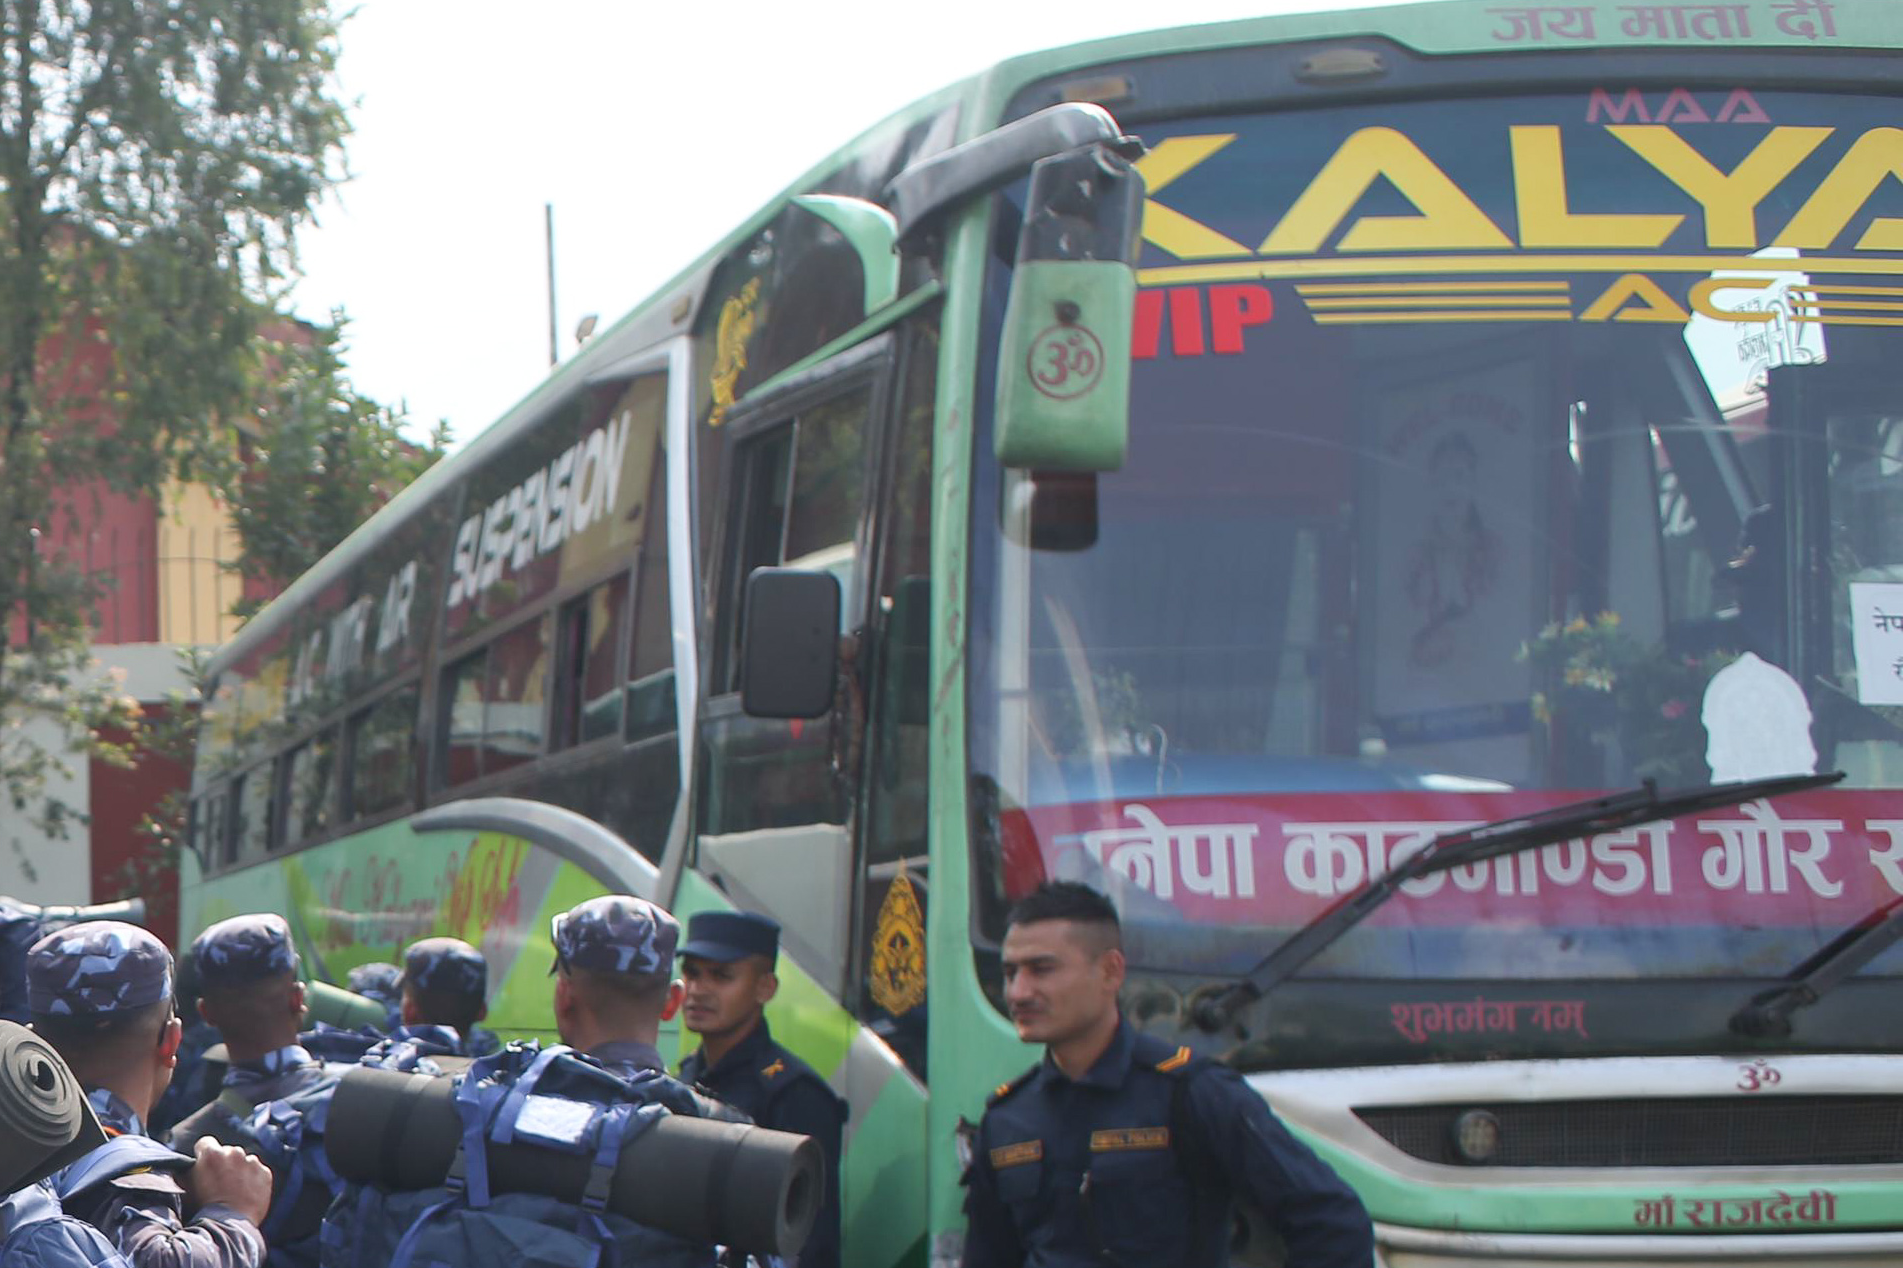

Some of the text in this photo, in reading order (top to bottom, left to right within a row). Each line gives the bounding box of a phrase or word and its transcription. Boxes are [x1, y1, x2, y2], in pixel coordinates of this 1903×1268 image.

[1485, 0, 1838, 42] जय माता दी
[1586, 87, 1772, 124] MAA
[1578, 273, 1779, 323] AC
[446, 409, 633, 608] SUSPENSION
[1697, 796, 1844, 899] गौर
[1682, 1188, 1839, 1228] राजदेवी
